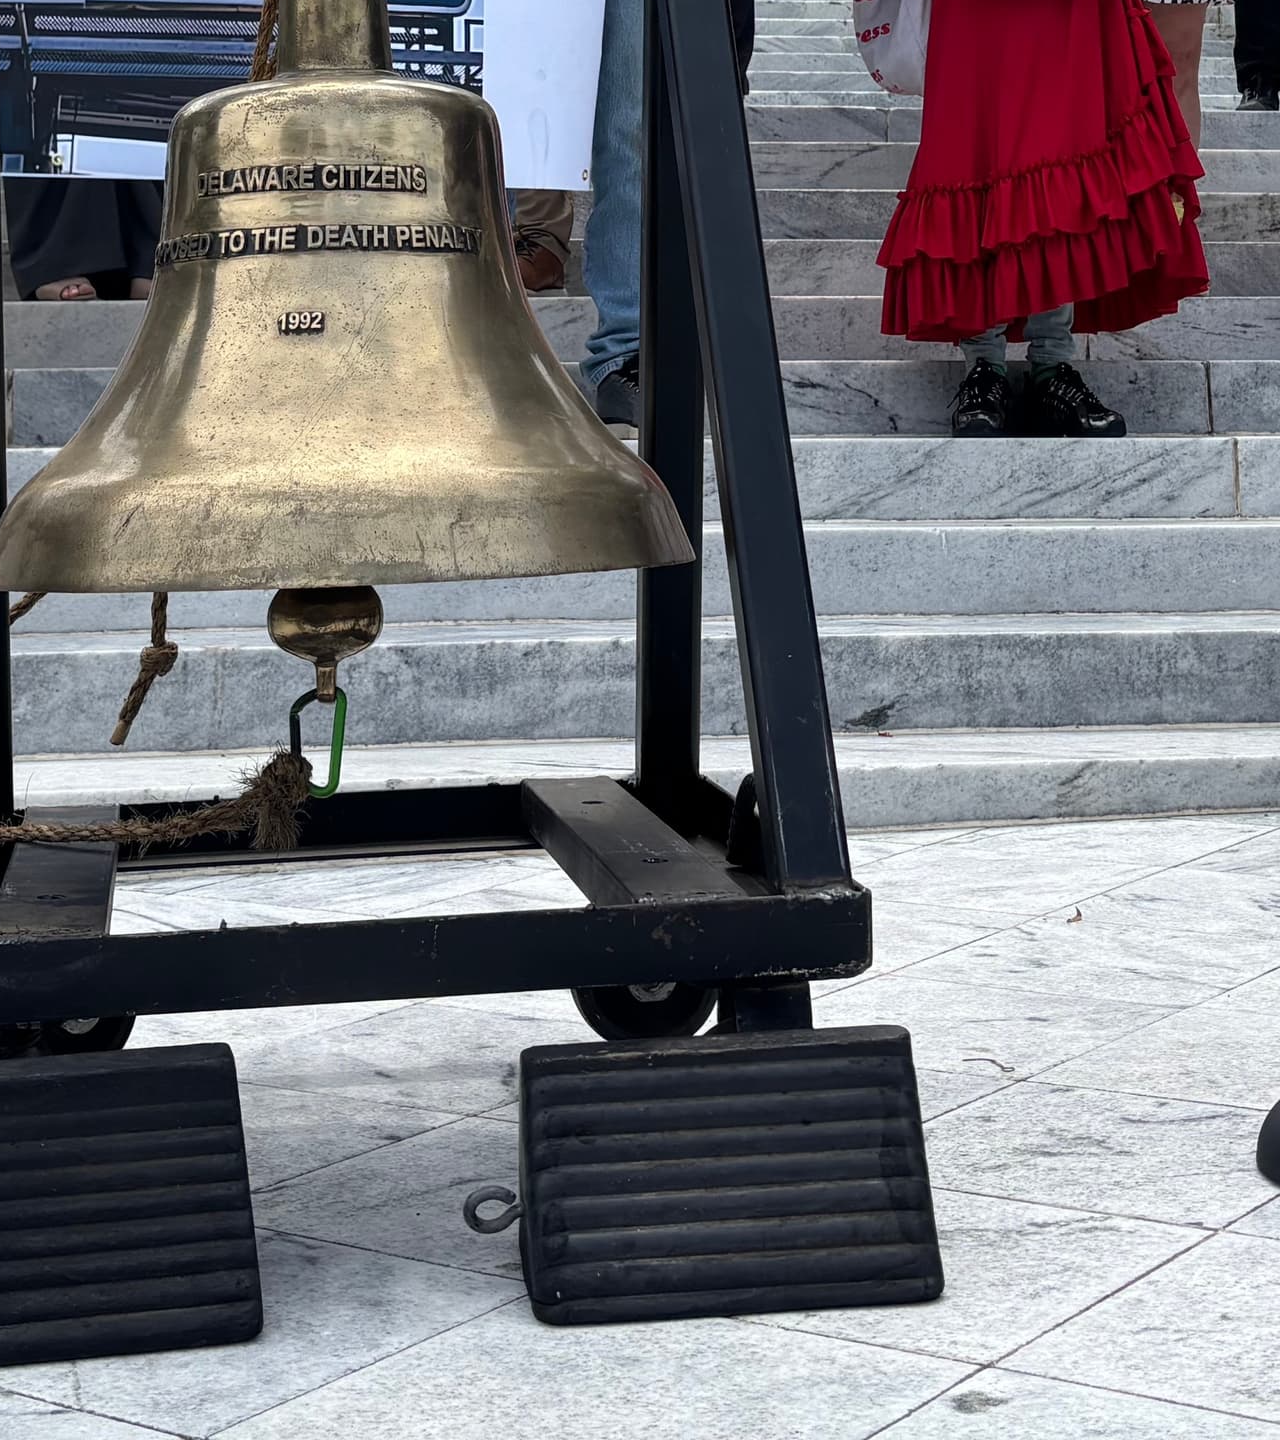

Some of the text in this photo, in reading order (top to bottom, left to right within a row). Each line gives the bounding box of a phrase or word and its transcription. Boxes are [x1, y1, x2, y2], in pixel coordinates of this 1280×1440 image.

[198, 164, 426, 194] DELAWARE CITIZENS
[219, 230, 245, 253] TO
[252, 227, 296, 250] THE
[307, 224, 388, 248] DEATH
[396, 225, 483, 254] PENALTY
[278, 312, 322, 331] 1992
